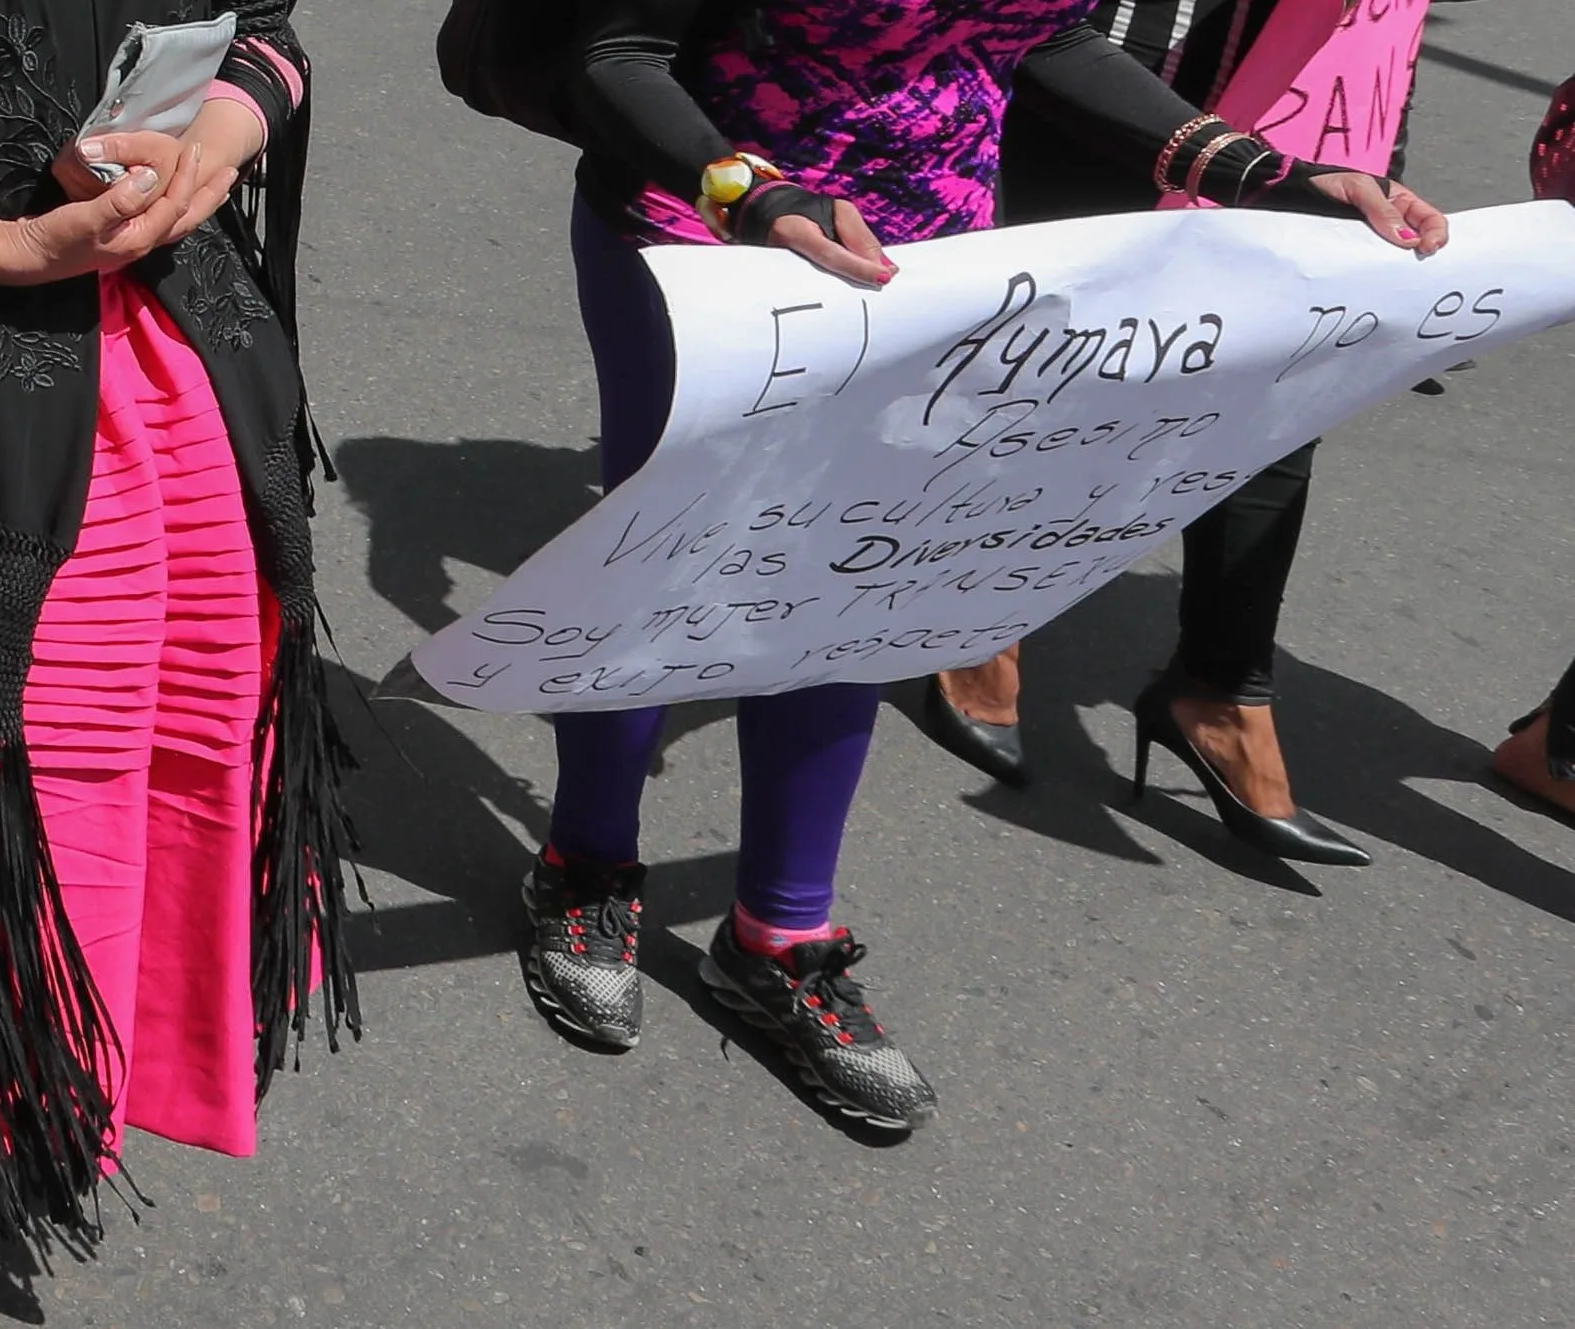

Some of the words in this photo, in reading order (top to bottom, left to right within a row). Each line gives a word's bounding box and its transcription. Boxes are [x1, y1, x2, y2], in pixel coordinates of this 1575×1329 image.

[1278, 304, 1379, 383] no
[1416, 287, 1504, 341] es
[471, 608, 622, 662] Soy
